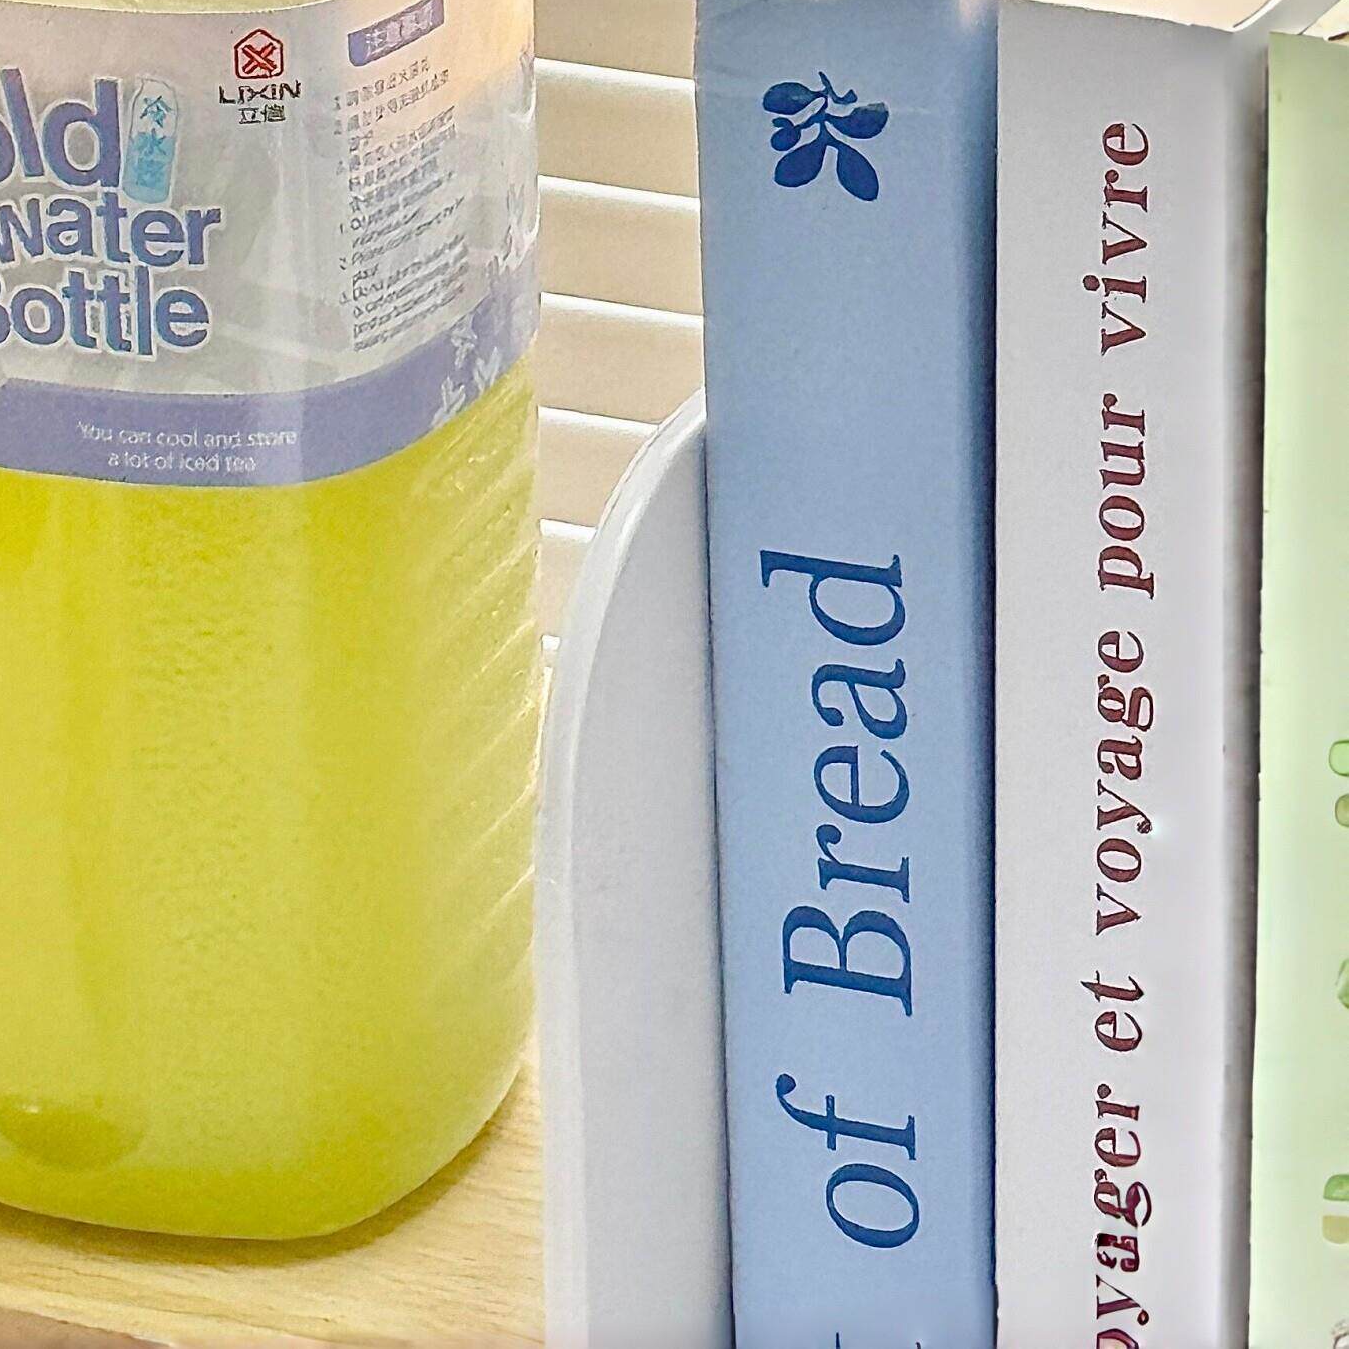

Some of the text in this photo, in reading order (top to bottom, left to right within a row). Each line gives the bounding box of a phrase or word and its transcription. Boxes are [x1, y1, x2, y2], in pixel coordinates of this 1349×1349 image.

[1082, 121, 1149, 356] vivre
[119, 429, 151, 444] can
[156, 427, 198, 447] cool
[203, 430, 241, 448] and
[1097, 392, 1155, 600] pour
[759, 548, 913, 1018] Bread
[1095, 629, 1154, 936] voyage
[1080, 970, 1145, 1053] et
[775, 1073, 920, 1249] of
